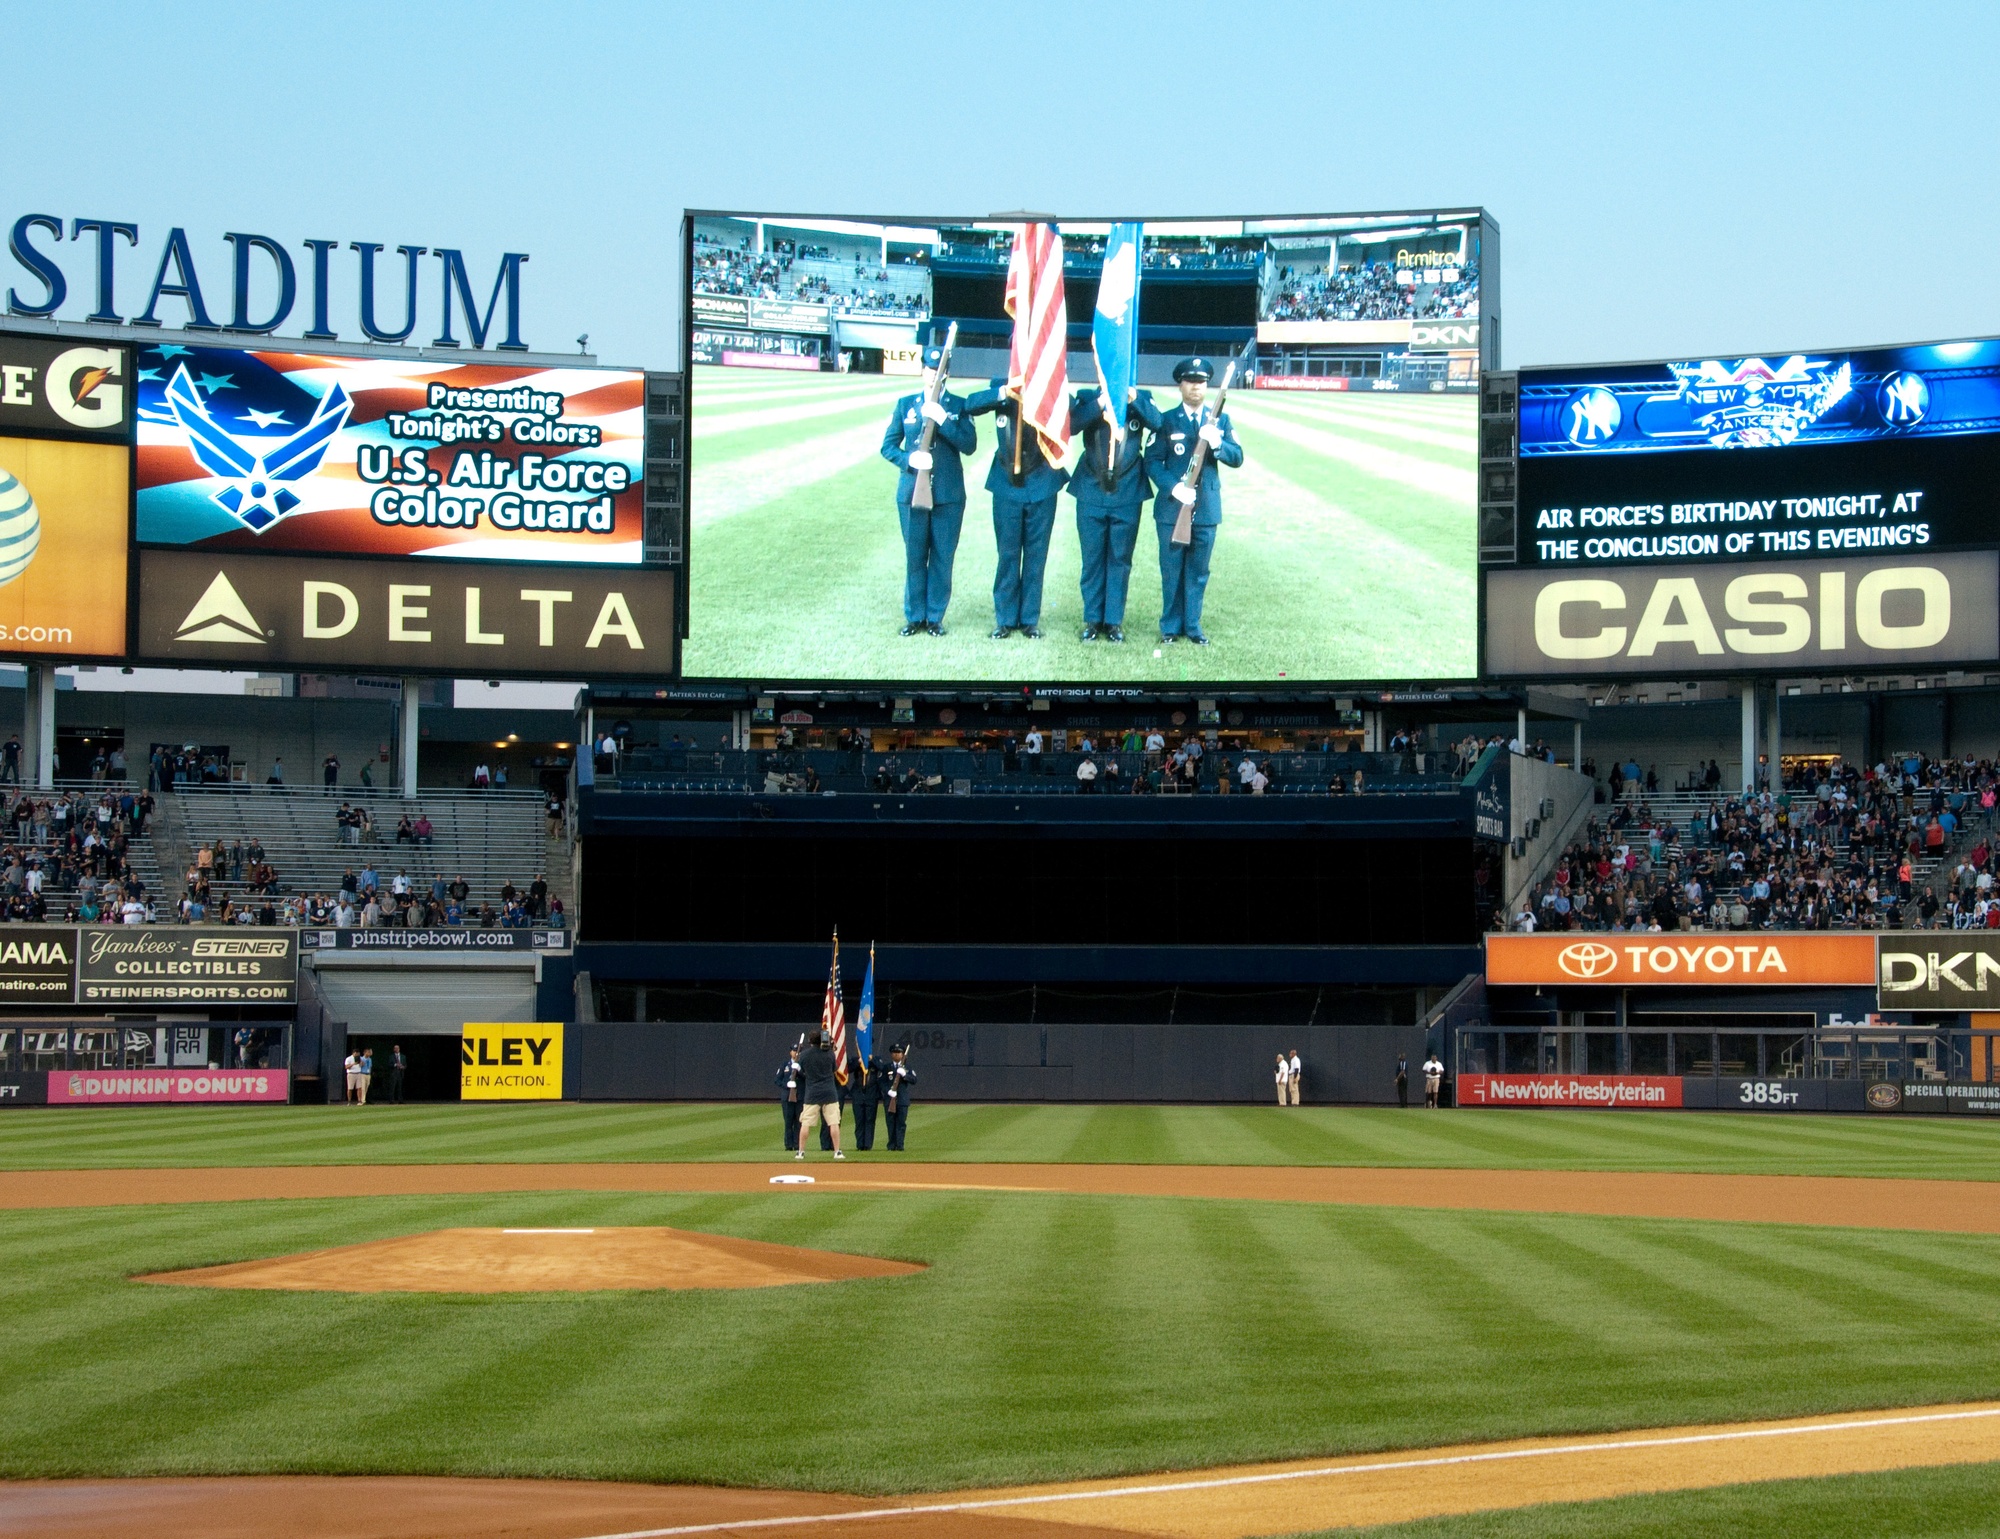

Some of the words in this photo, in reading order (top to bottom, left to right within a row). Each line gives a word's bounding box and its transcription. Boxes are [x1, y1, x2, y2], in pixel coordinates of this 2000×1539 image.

[6, 213, 530, 351] STADIUM
[430, 385, 560, 415] Presenting
[1686, 389, 1737, 404] NEW
[389, 415, 500, 441] Tonight's
[514, 421, 598, 443] Colors:
[361, 448, 439, 483] U.S.
[451, 453, 510, 485] Air
[522, 456, 627, 490] Force
[374, 490, 481, 525] Color
[492, 496, 611, 530] Guard
[1537, 509, 1574, 529] AIR
[1580, 504, 1664, 527] FORCE'S
[1671, 500, 1777, 524] BIRTHDAY
[1782, 494, 1886, 518] TONIGHT,
[1893, 492, 1922, 512] AT
[1537, 540, 1578, 560] THE
[1584, 534, 1718, 559] CONCLUSION
[1725, 532, 1754, 553] OF
[1759, 530, 1811, 552] THIS
[1817, 524, 1929, 549] EVENING'S
[303, 580, 645, 650] DELTA
[1534, 566, 1951, 659] CASIO
[0, 941, 68, 964] AMA
[88, 931, 177, 965] Yankees
[195, 941, 286, 954] STEINER
[351, 930, 514, 948] pinstripebowl.com
[115, 961, 261, 975] COLLECTIBLES
[1625, 946, 1787, 973] TOYOTA
[86, 987, 288, 998] STEINERSPORTS.COM
[86, 1077, 175, 1095] DUNKIN'
[178, 1077, 268, 1094] DONUTS
[477, 1076, 490, 1086] IN
[494, 1076, 545, 1086] ACTION
[1904, 1085, 1944, 1097] SPECIAL
[1945, 1086, 2000, 1098] OPERATIONS
